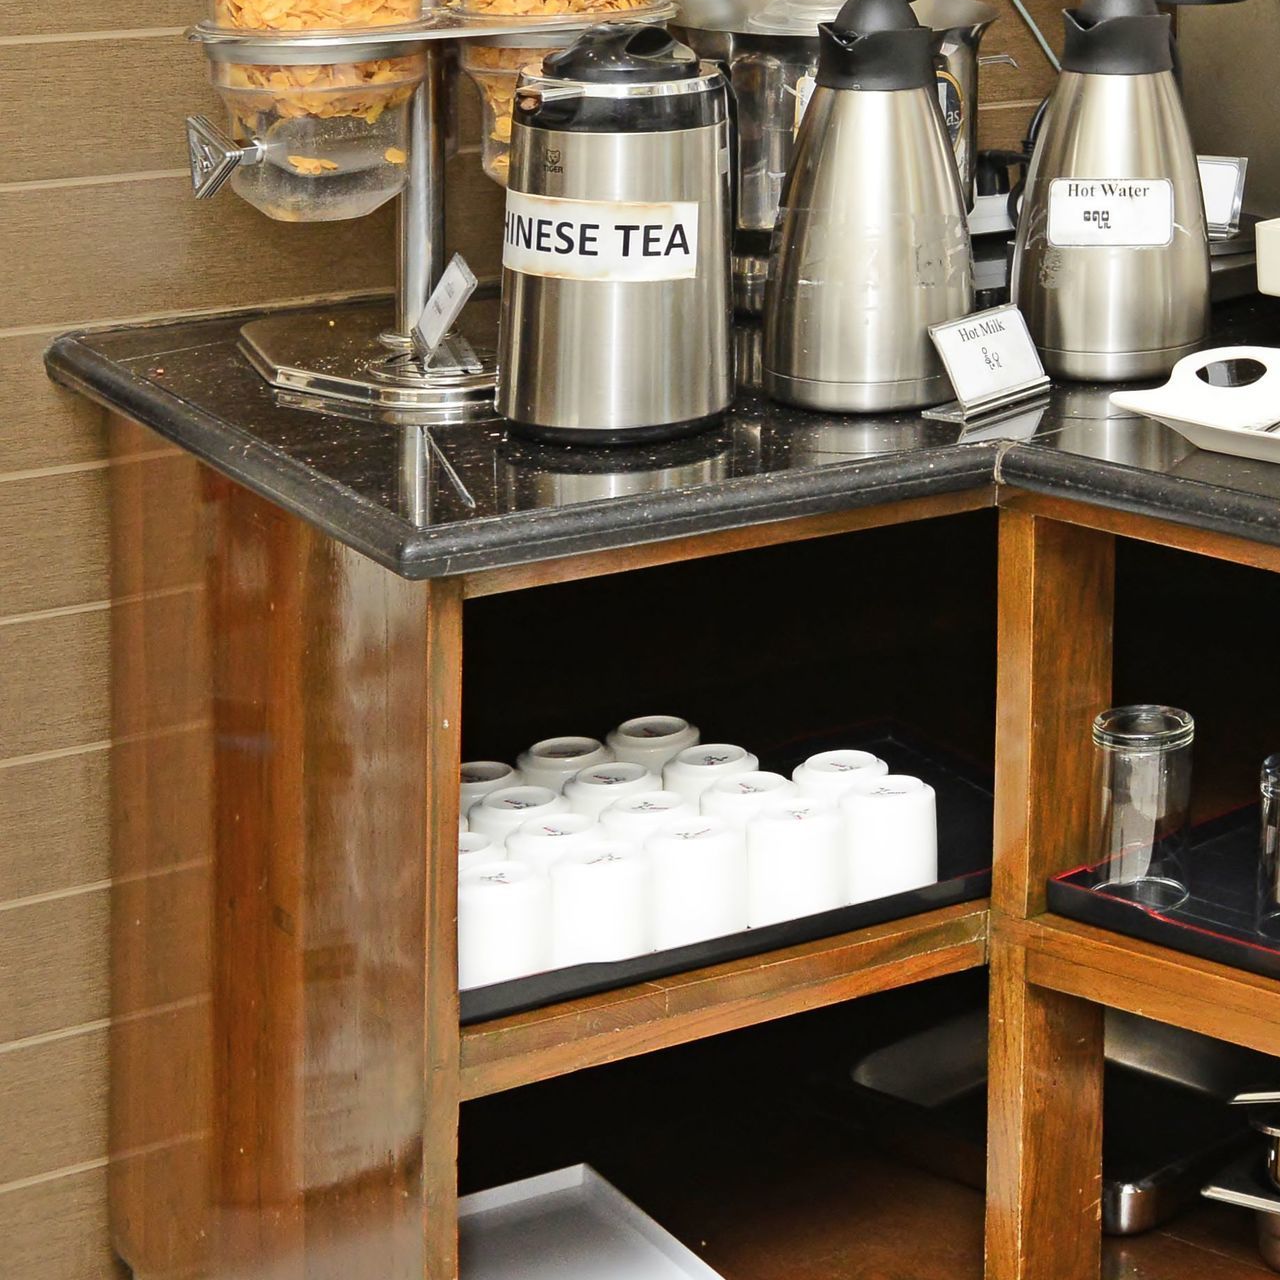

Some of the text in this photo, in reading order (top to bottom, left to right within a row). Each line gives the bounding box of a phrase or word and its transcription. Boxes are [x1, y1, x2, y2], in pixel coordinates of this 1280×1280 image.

[1068, 183, 1150, 199] Hot Water
[504, 210, 690, 257] HINESE TEA
[958, 318, 1006, 342] Hot Milk
